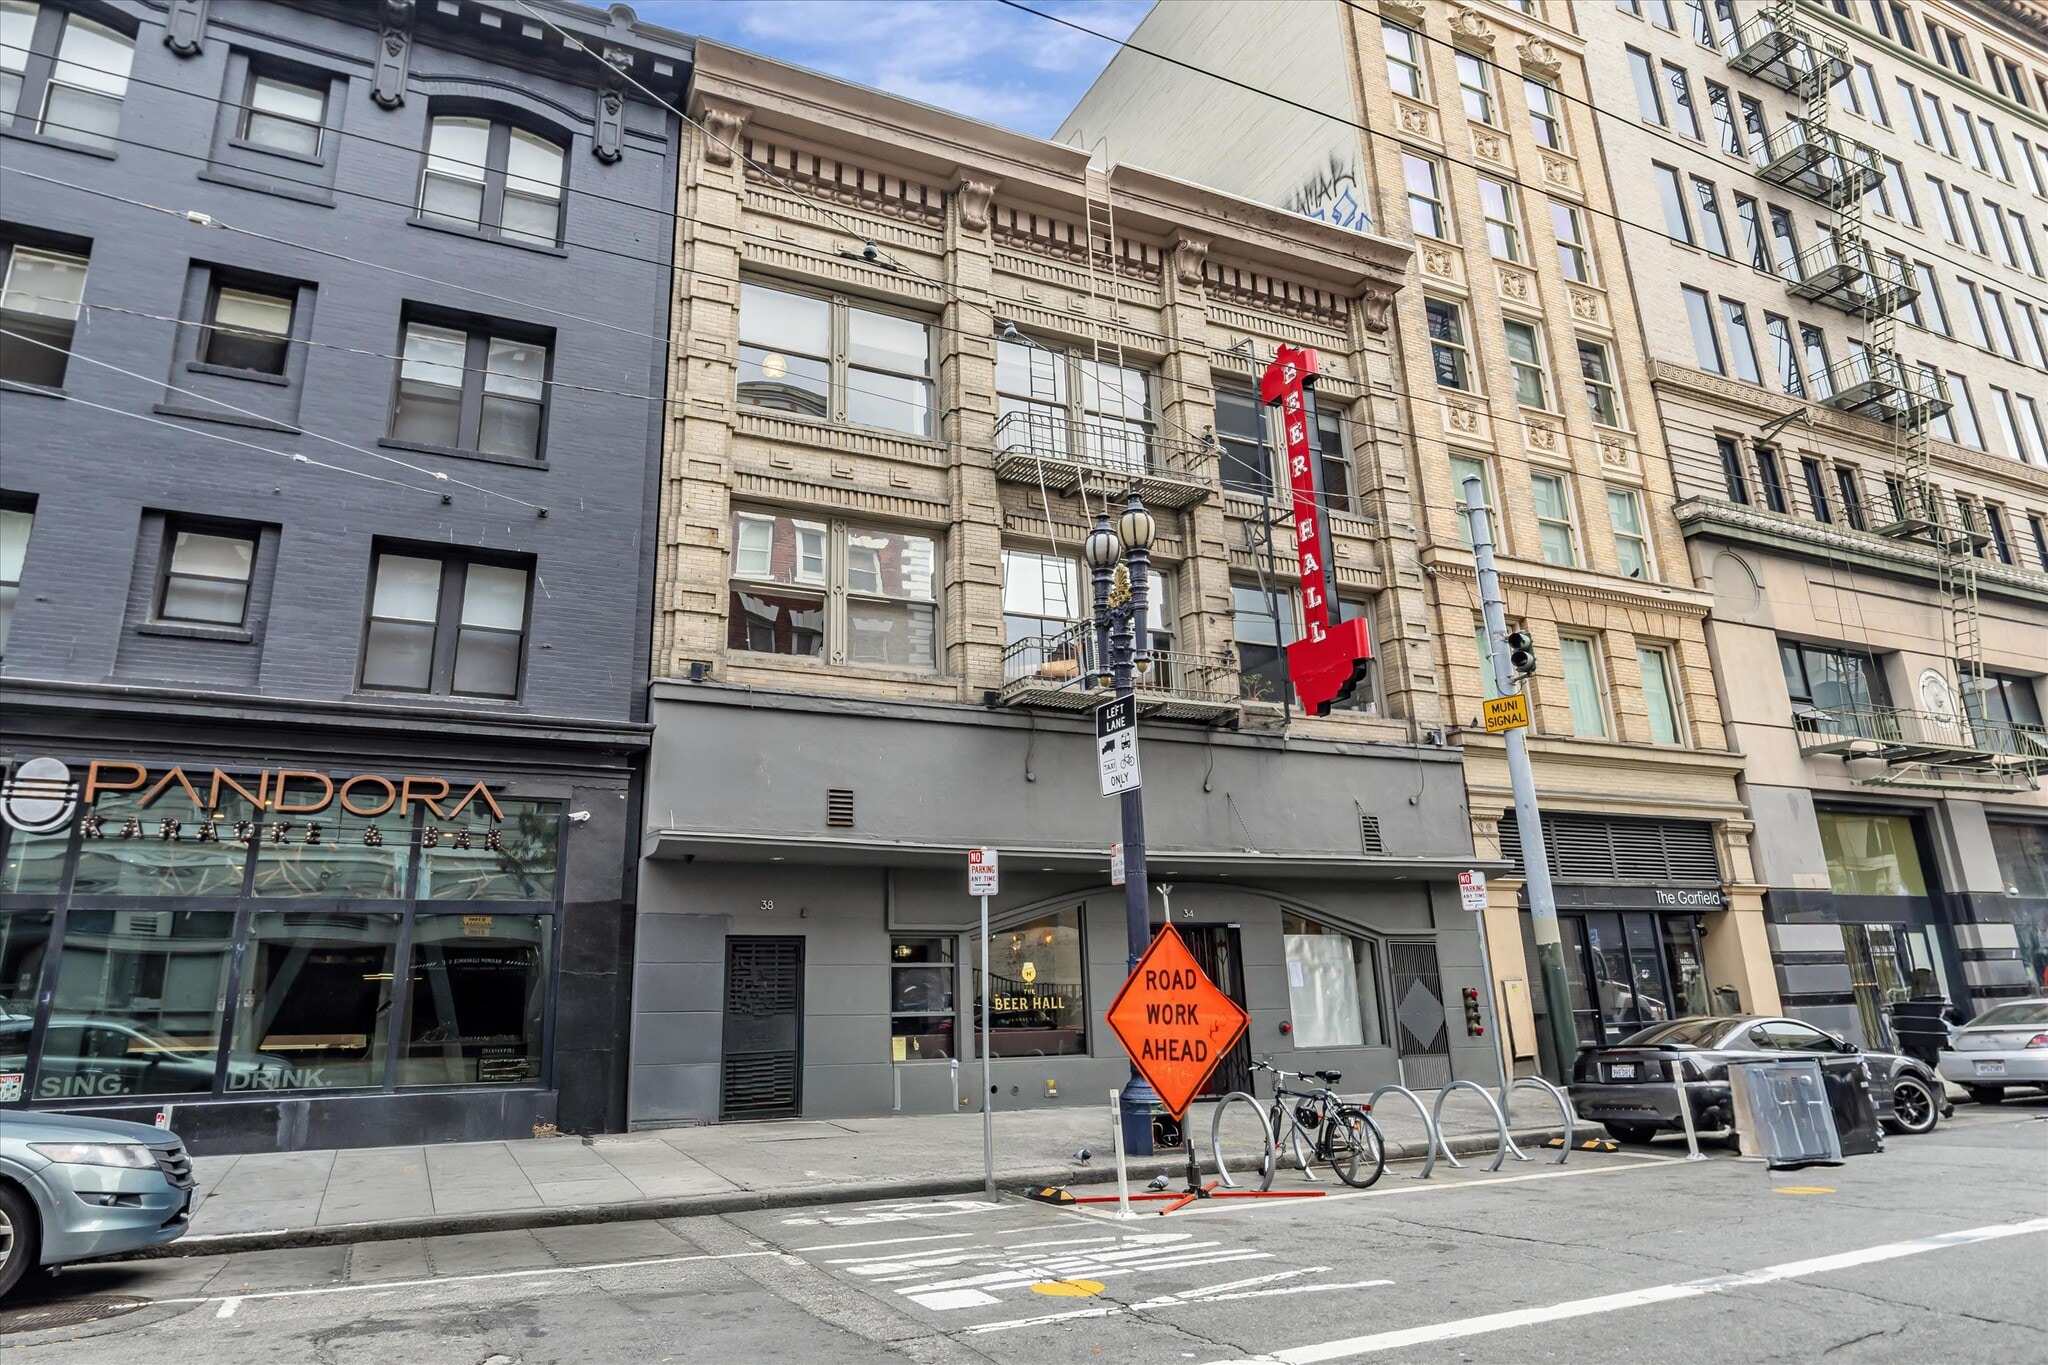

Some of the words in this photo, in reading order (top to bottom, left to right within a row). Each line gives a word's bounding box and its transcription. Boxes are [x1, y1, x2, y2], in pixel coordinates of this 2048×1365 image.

[1282, 361, 1308, 478] BEER
[1299, 517, 1327, 644] HALL
[1106, 703, 1125, 719] LEFT
[1491, 700, 1518, 714] MUNI
[1106, 716, 1126, 733] LANE
[1488, 712, 1526, 727] SIGNAL
[1111, 772, 1129, 787] ONLY
[84, 761, 505, 820] PANDORA
[80, 815, 321, 844] KARAOKE
[363, 824, 382, 846] &
[423, 826, 501, 850] BAR
[970, 851, 981, 863] NO
[971, 865, 996, 874] PARKING
[1460, 874, 1470, 884] NO
[1463, 884, 1485, 893] PARKING
[760, 899, 774, 910] 38
[1656, 890, 1675, 904] The
[1677, 890, 1721, 905] Garfield
[1183, 908, 1194, 918] 34
[1145, 969, 1197, 990] ROAD
[994, 997, 1028, 1011] BEER
[1033, 997, 1065, 1009] HALL
[1147, 1004, 1199, 1025] WORK
[1142, 1039, 1208, 1063] AHEAD
[40, 1074, 130, 1097] SING.
[229, 1068, 333, 1090] DRINK.
